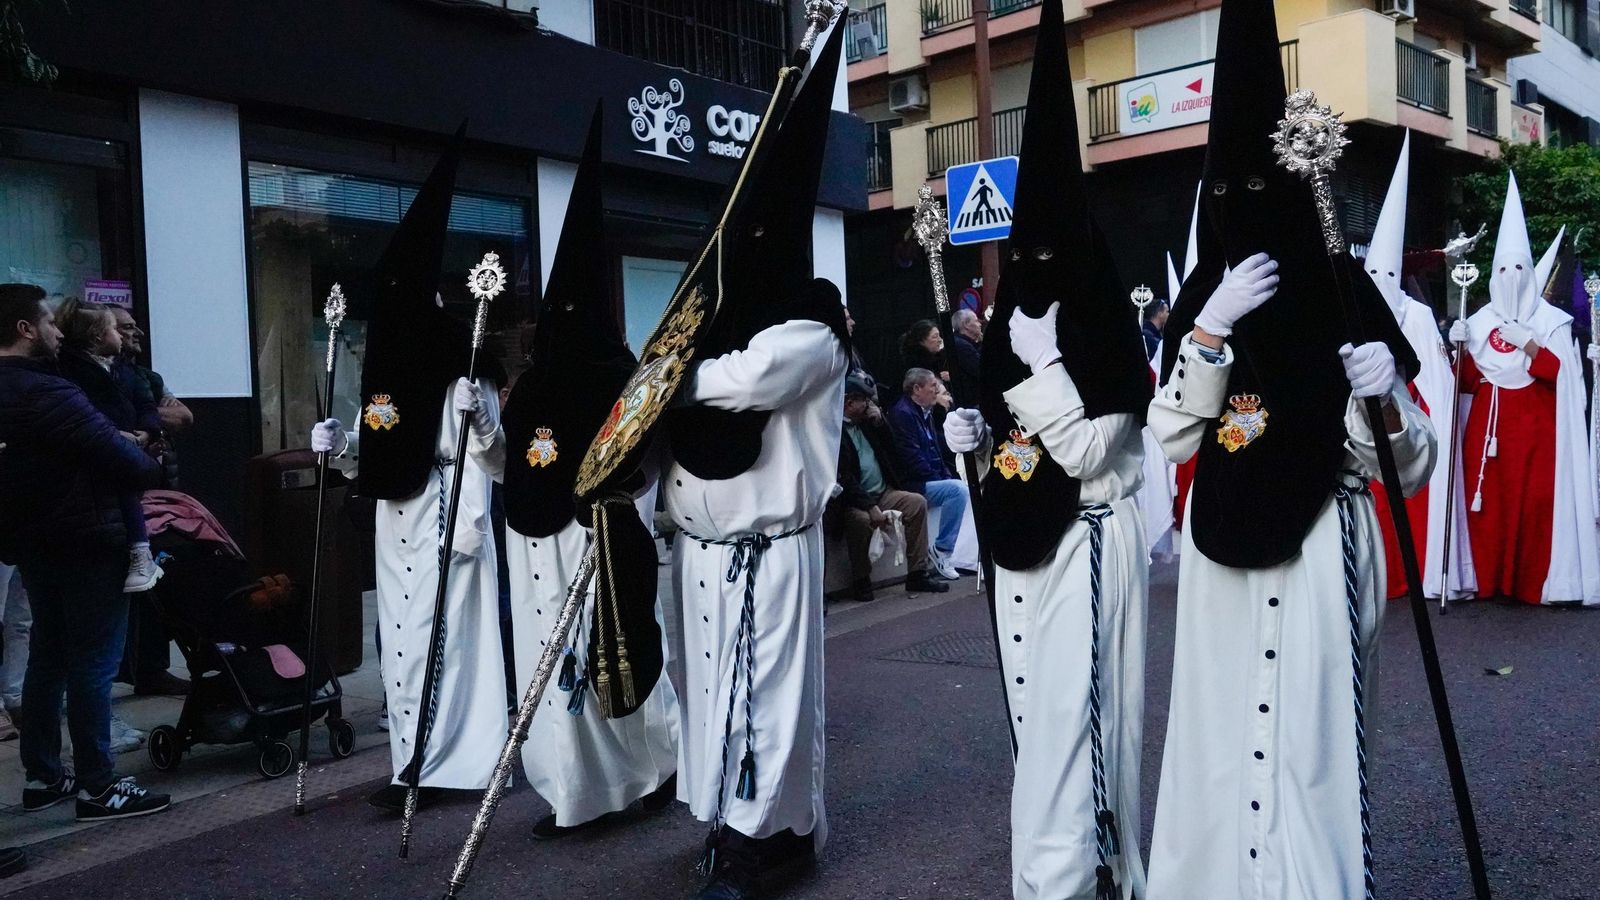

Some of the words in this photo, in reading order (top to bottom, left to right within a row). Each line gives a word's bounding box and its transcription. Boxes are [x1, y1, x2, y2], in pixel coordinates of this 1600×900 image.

[1171, 102, 1181, 113] LA
[87, 291, 130, 304] flexol
[105, 794, 129, 809] N
